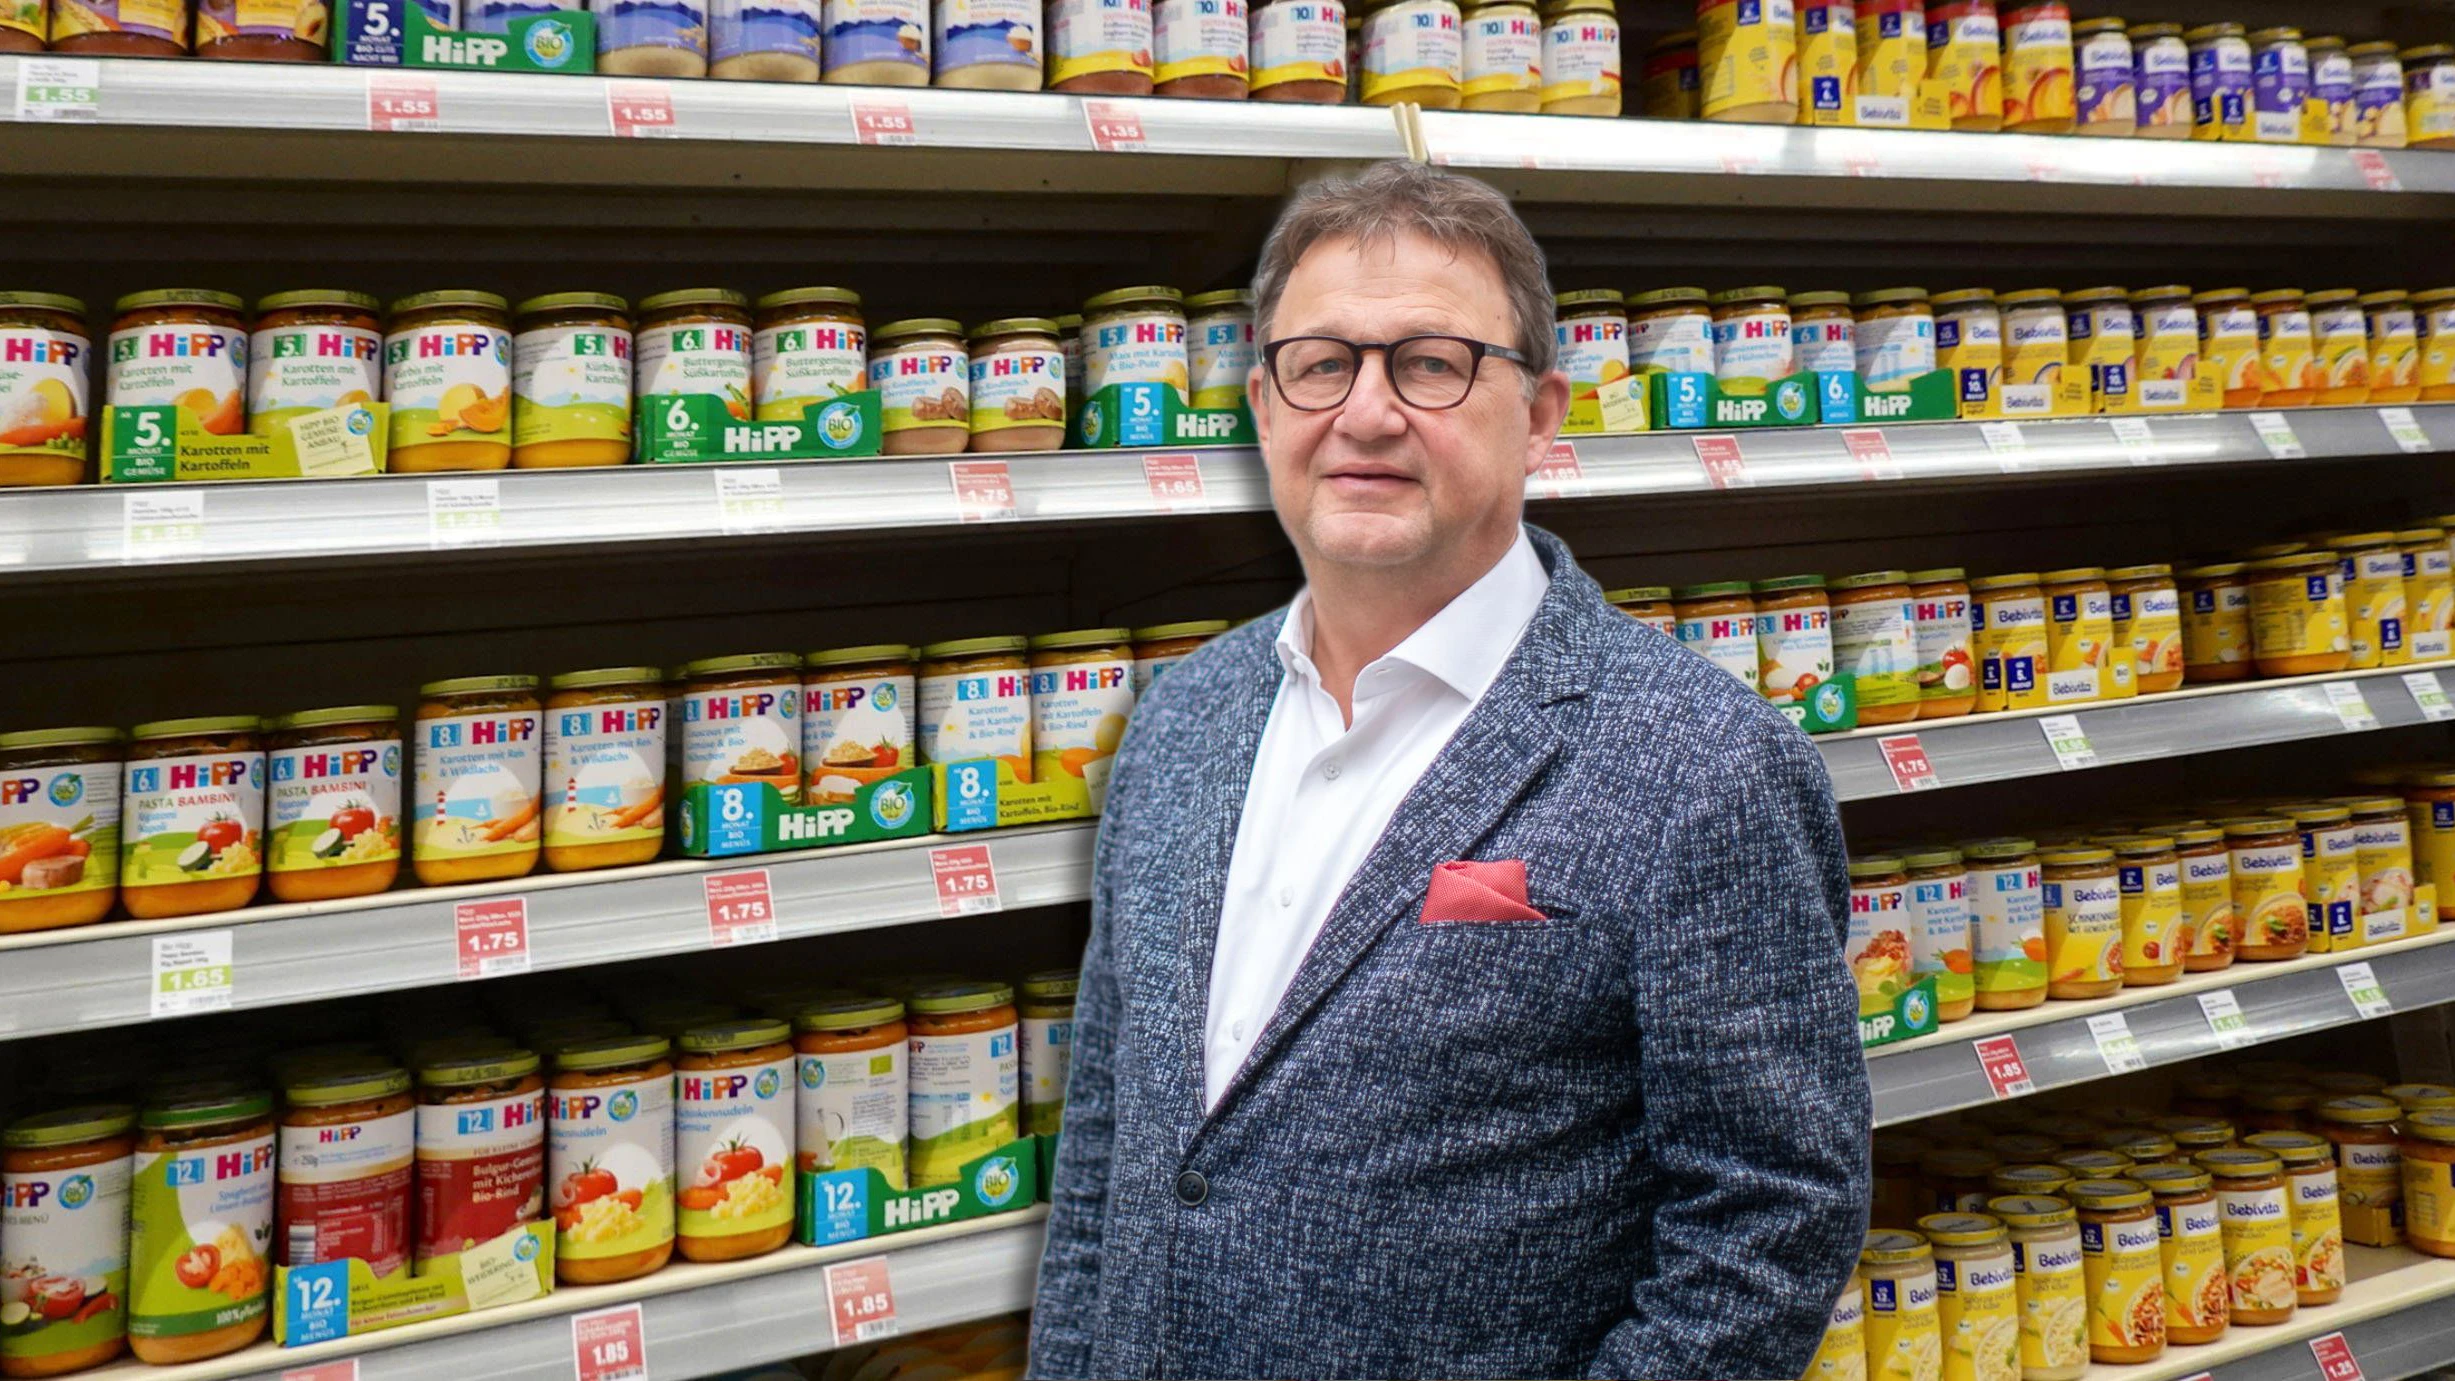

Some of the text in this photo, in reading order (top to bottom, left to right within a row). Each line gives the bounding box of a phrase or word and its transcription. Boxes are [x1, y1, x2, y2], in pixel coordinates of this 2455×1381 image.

[363, 2, 400, 36] 5.
[423, 36, 508, 65] HiPP
[536, 36, 562, 50] BIO
[36, 87, 91, 101] 1.55
[379, 101, 430, 115] 1.55
[620, 107, 668, 121] 1.55
[863, 115, 908, 131] 1.55
[815, 330, 864, 353] HiPP
[1136, 323, 1185, 346] HiPP
[1574, 323, 1623, 343] HiPP
[1744, 321, 1789, 341] HiPP
[5, 338, 79, 366] HiPP
[149, 333, 226, 357] HiPP
[281, 338, 300, 357] 5.
[318, 333, 378, 364] HiPP
[419, 333, 489, 358] HiPP
[582, 336, 601, 356] 5.
[680, 333, 700, 352] 6.
[784, 334, 802, 351] 6.
[900, 356, 952, 377] HiPP
[994, 356, 1045, 377] HiPP
[1679, 376, 1703, 402] 5.
[1828, 375, 1849, 400] 6.
[1132, 387, 1161, 417] 5.
[1716, 401, 1768, 422] HiPP
[1865, 395, 1912, 418] HiPP
[665, 398, 700, 432] 6.
[827, 417, 853, 431] BIO
[1176, 412, 1238, 438] HiPP
[134, 412, 172, 447] 5.
[724, 426, 803, 454] HiPP
[179, 443, 270, 457] Karotten mit
[135, 456, 155, 467] BIO
[180, 458, 251, 472] Kartoffeln
[1784, 611, 1828, 633] HiPP
[1917, 602, 1966, 622] HiPP
[1711, 618, 1754, 640] HiPP
[966, 679, 981, 700] 8.
[1066, 667, 1125, 692] HiPP
[708, 692, 774, 720] HiPP
[806, 686, 866, 714] HiPP
[472, 717, 536, 746] HiPP
[568, 716, 585, 736] 8.
[602, 706, 660, 736] HiPP
[438, 726, 455, 746] 8.
[303, 750, 377, 778] HiPP
[1897, 759, 1928, 773] 1.75
[169, 760, 246, 790] HiPP
[959, 767, 990, 798] 8.
[277, 781, 367, 799] PASTA BAMBINI
[1037, 795, 1052, 805] mit
[139, 792, 236, 810] PASTA BAMBINI
[721, 787, 754, 822] 8.
[880, 795, 906, 813] BIO
[778, 808, 855, 841] HiPP
[2241, 854, 2294, 873] Bebivita
[945, 875, 989, 893] 1.75
[718, 901, 766, 921] 1.75
[1851, 893, 1903, 913] HiPP
[468, 931, 520, 953] 1.75
[168, 965, 225, 989] 1.65
[1992, 1063, 2021, 1082] 1.85
[683, 1074, 748, 1101] HiPP
[468, 1112, 487, 1132] 12
[320, 1126, 361, 1144] HiPP
[172, 1162, 194, 1184] 12
[216, 1145, 275, 1181] HiPP
[472, 1177, 492, 1190] mit
[984, 1173, 1010, 1190] BIO
[472, 1185, 520, 1204] Bio-Rind
[824, 1183, 862, 1213] 12.
[884, 1189, 960, 1228] HiPP
[2227, 1200, 2280, 1218] Bebivita
[296, 1277, 342, 1311] 12.
[843, 1293, 889, 1319] 1.85
[591, 1341, 629, 1365] 1.85
